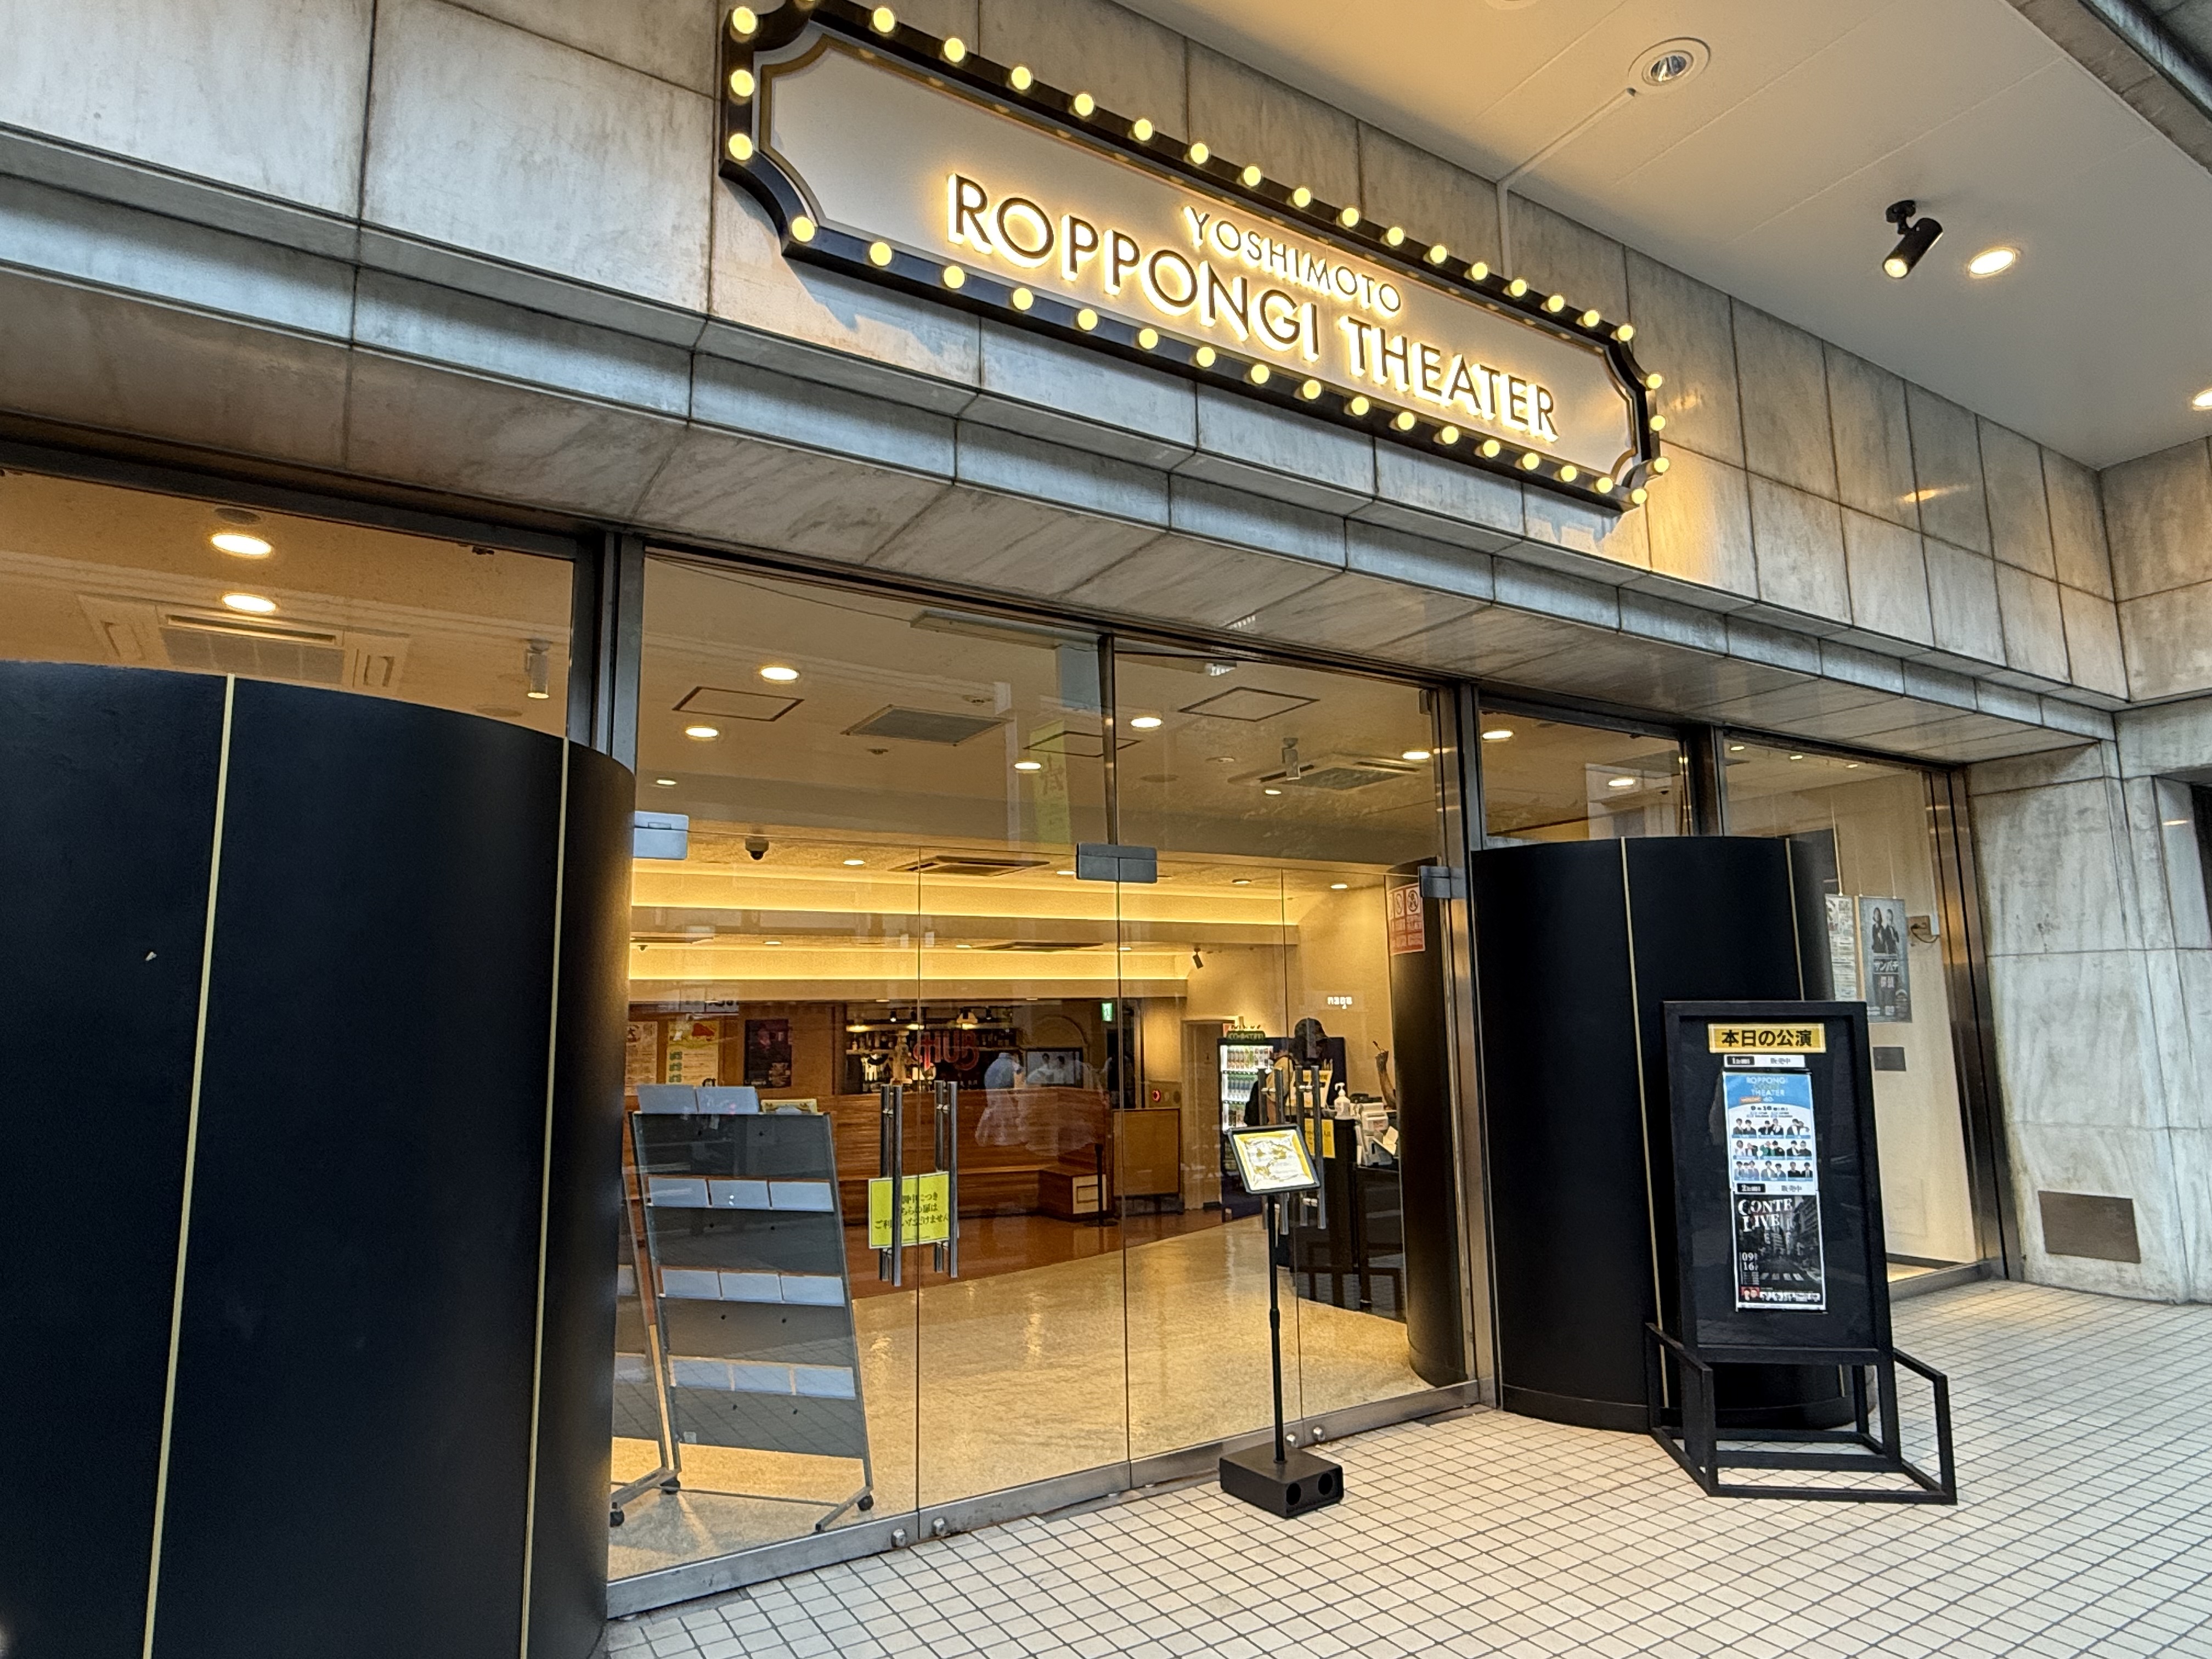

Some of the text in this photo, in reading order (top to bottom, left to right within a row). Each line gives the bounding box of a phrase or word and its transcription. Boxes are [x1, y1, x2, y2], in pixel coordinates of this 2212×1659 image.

[1184, 205, 1401, 317] YOSHIMOTO
[949, 173, 1559, 442] ROPPONGI THEATER
[913, 1031, 979, 1071] HUB
[1722, 1029, 1812, 1047] 本日の公演
[1738, 1198, 1793, 1216] CONTE
[1742, 1214, 1780, 1232] LIVE
